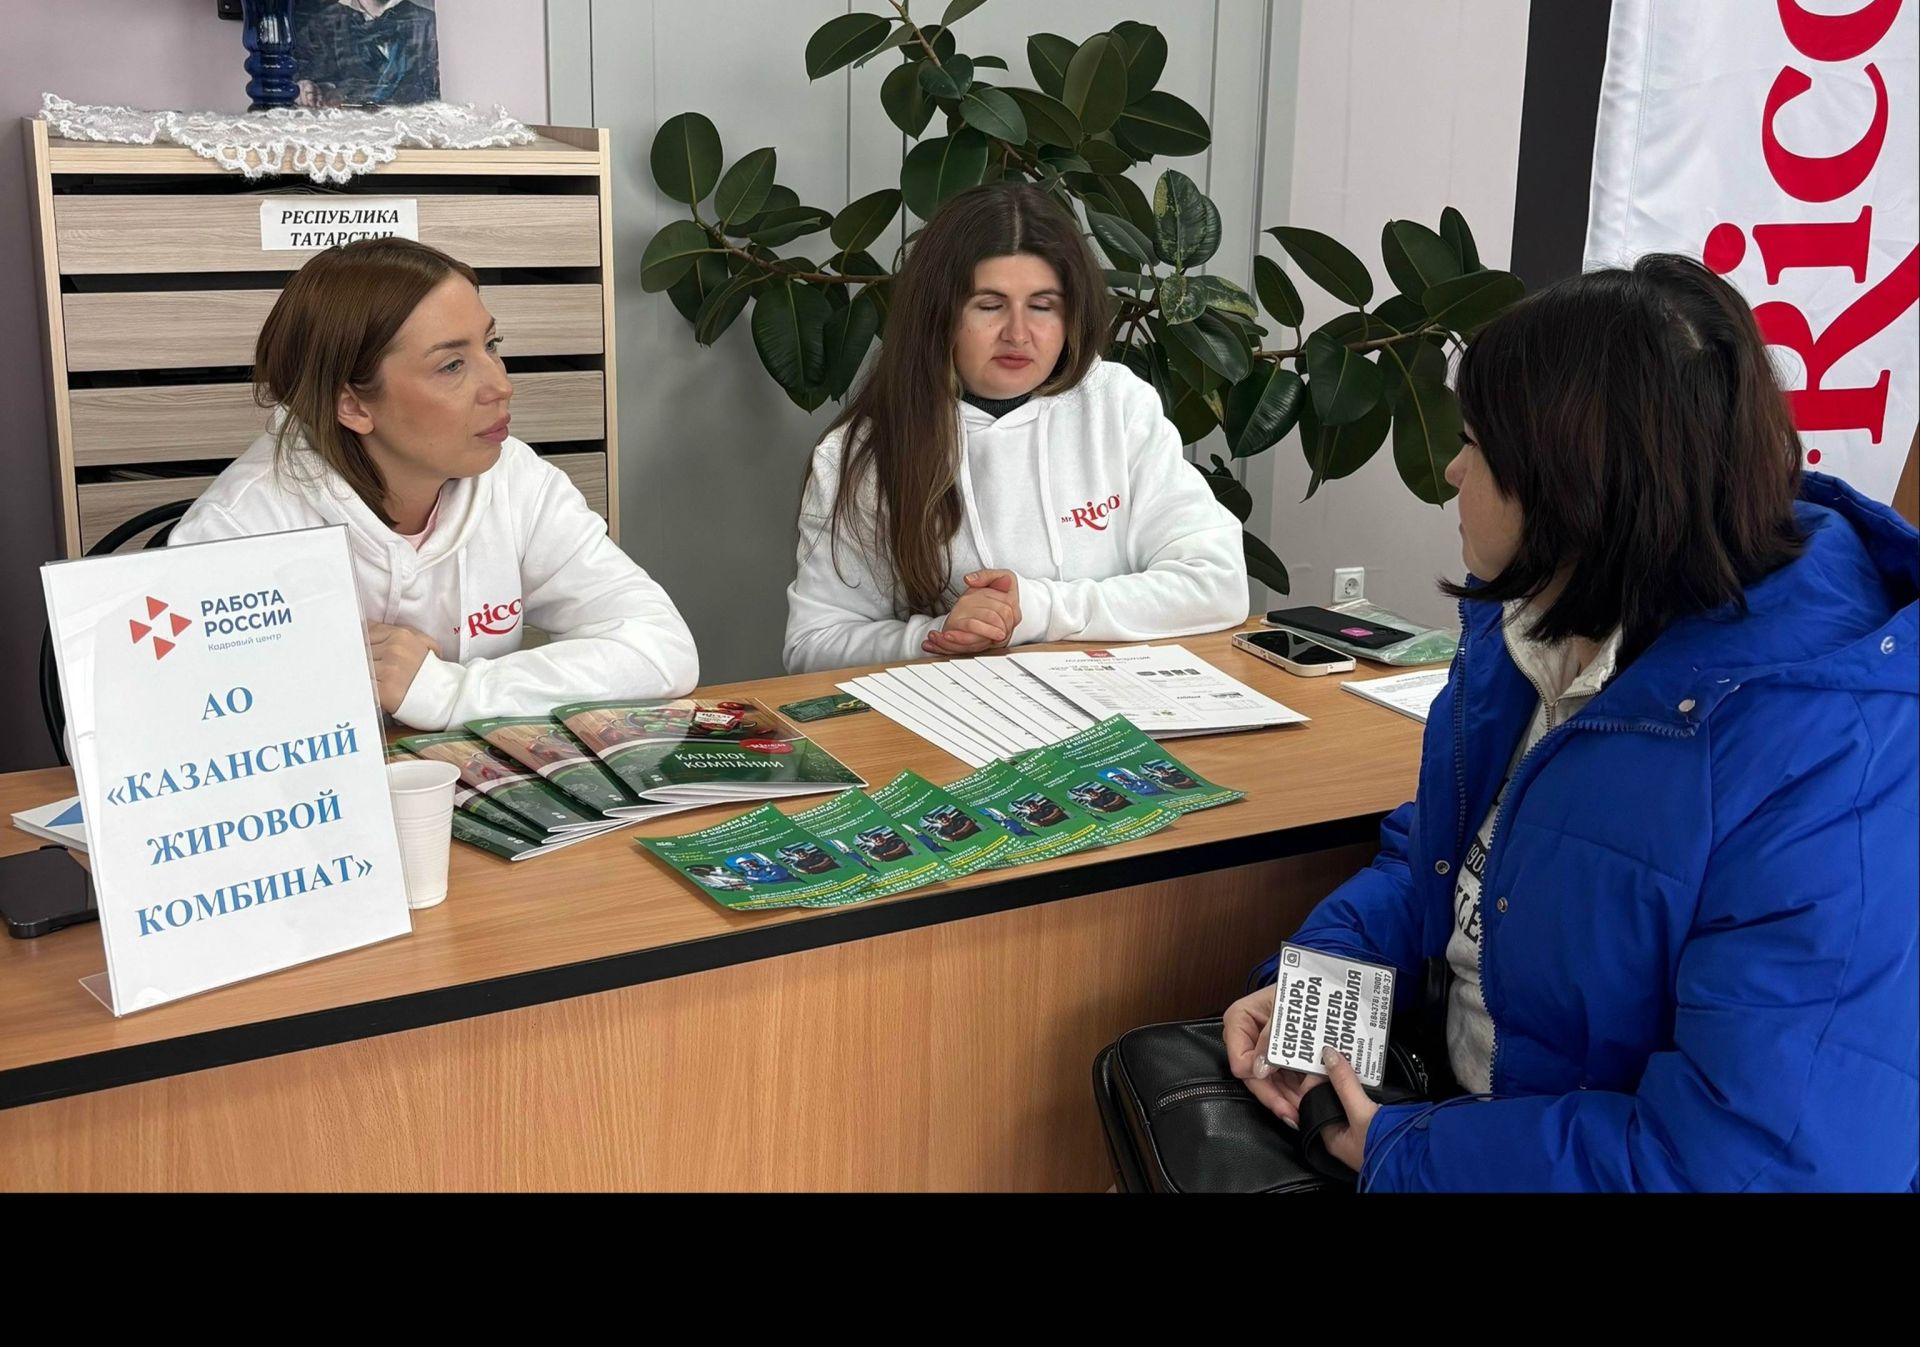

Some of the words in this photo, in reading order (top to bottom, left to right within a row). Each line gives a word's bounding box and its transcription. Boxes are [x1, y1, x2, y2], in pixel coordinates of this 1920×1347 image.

[281, 210, 399, 224] РЕСПУБЛИКА
[201, 589, 285, 616] РАБОТА
[204, 608, 292, 637] РОССИИ
[208, 637, 254, 651] Кадровый
[256, 633, 282, 644] центр
[201, 687, 253, 720] АО
[107, 722, 359, 806] «КАЗАНСКИЙ
[684, 761, 784, 769] КОМПАНИИ
[147, 791, 342, 865] ЖИРОВОЙ
[136, 856, 373, 936] КОМБИНАТ»
[1282, 980, 1305, 1059] СЕКРЕТАРЬ
[1298, 977, 1322, 1063] ДИРЕКТОРА
[1321, 991, 1342, 1065] ДИТЕЛЬ
[1338, 969, 1361, 1064] ВТОМОБИЛЯ
[1354, 1038, 1365, 1074] (легковой)
